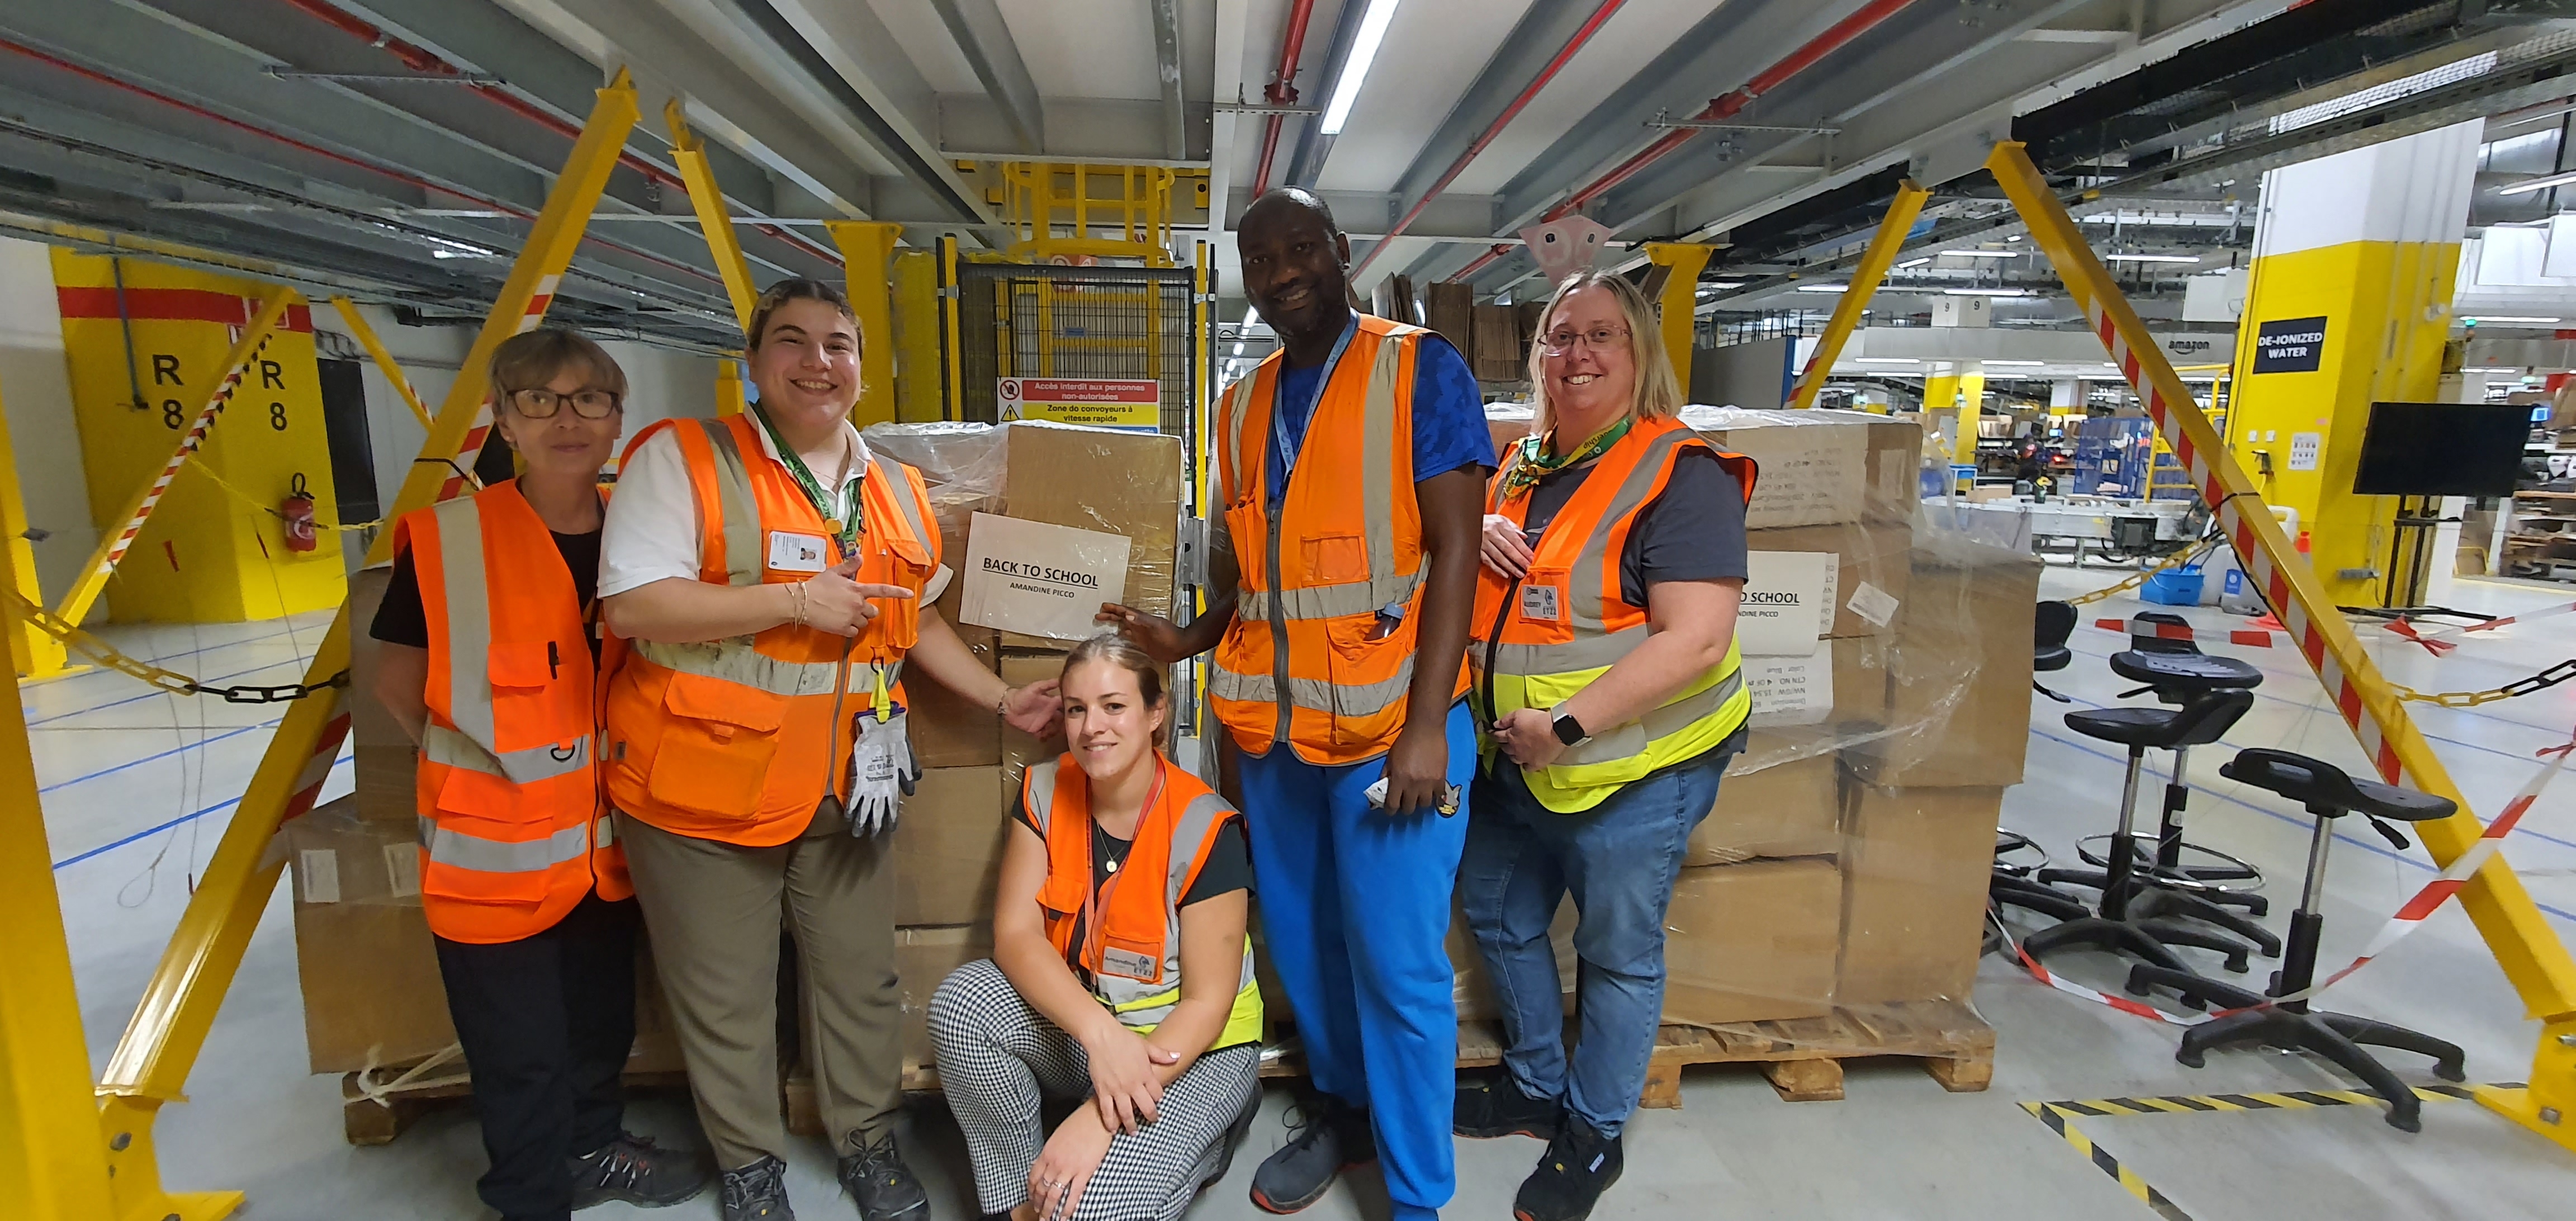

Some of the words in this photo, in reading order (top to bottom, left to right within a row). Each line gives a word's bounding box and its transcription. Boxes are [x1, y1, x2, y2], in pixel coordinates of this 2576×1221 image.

[1945, 302, 1950, 312] 9
[1974, 301, 1980, 310] 9
[2168, 340, 2210, 350] amazon
[2258, 332, 2323, 347] DE-IONIZED
[2268, 347, 2308, 359] WATER
[153, 354, 183, 386] R
[260, 360, 286, 390] R
[163, 400, 184, 430] 8
[270, 403, 287, 431] 8
[1093, 415, 1117, 423] rapide
[983, 557, 1019, 574] BACK
[1022, 564, 1041, 577] TO
[1044, 567, 1098, 586] SCHOOL
[1010, 583, 1051, 594] AMANDINE
[1053, 589, 1074, 598] PICCO
[1750, 592, 1800, 603] SCHOOL
